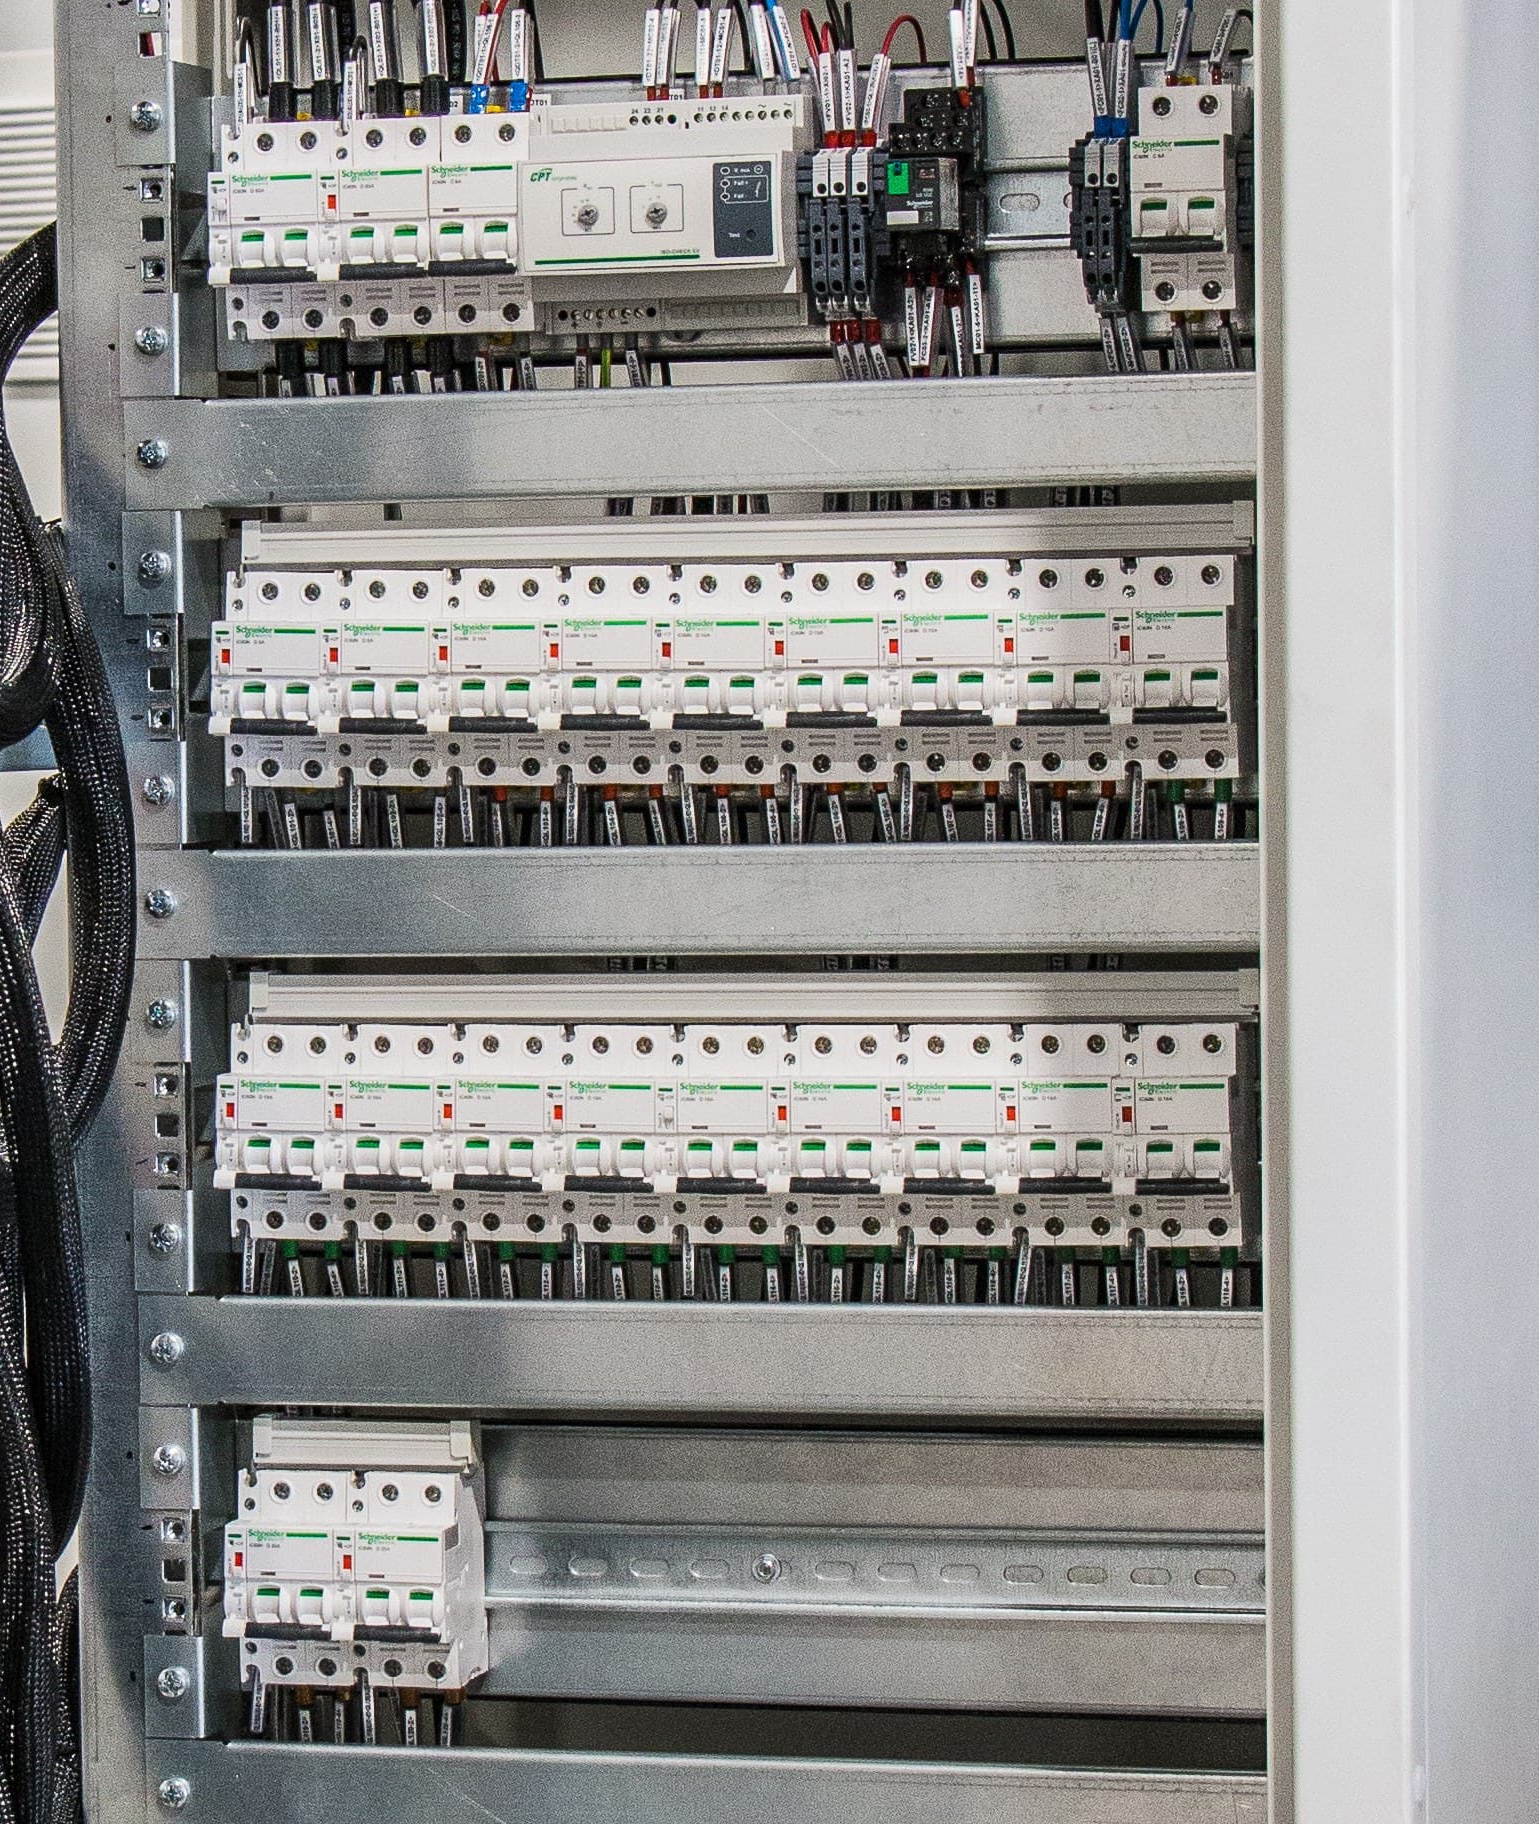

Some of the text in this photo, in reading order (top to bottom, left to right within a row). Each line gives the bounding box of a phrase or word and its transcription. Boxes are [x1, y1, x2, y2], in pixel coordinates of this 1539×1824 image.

[1132, 140, 1172, 153] Schneider
[342, 170, 378, 182] Schneider
[431, 166, 468, 178] Schneider
[530, 169, 552, 182] CPT
[232, 174, 268, 187] Schneider
[789, 616, 827, 629] Schneider
[903, 614, 941, 626] Schneider
[1019, 612, 1058, 626] Schneider
[1135, 610, 1173, 623] Schneider
[344, 624, 381, 636] Schneider
[453, 624, 491, 636] Schneider
[565, 619, 602, 632] Schneider
[676, 618, 715, 632] Schneider
[236, 626, 272, 638] Schneider
[241, 1080, 277, 1092] Schneider
[349, 1080, 386, 1092] Schneider
[459, 1080, 496, 1092] Schneider
[569, 1080, 607, 1093] Schneider
[680, 1082, 718, 1095] Schneider
[793, 1082, 831, 1094] Schneider
[907, 1082, 946, 1094] Schneider
[1021, 1080, 1061, 1094] Schneider
[1137, 1082, 1177, 1095] Schneider
[248, 1528, 284, 1541] Schneider
[359, 1532, 395, 1544] Schneider
